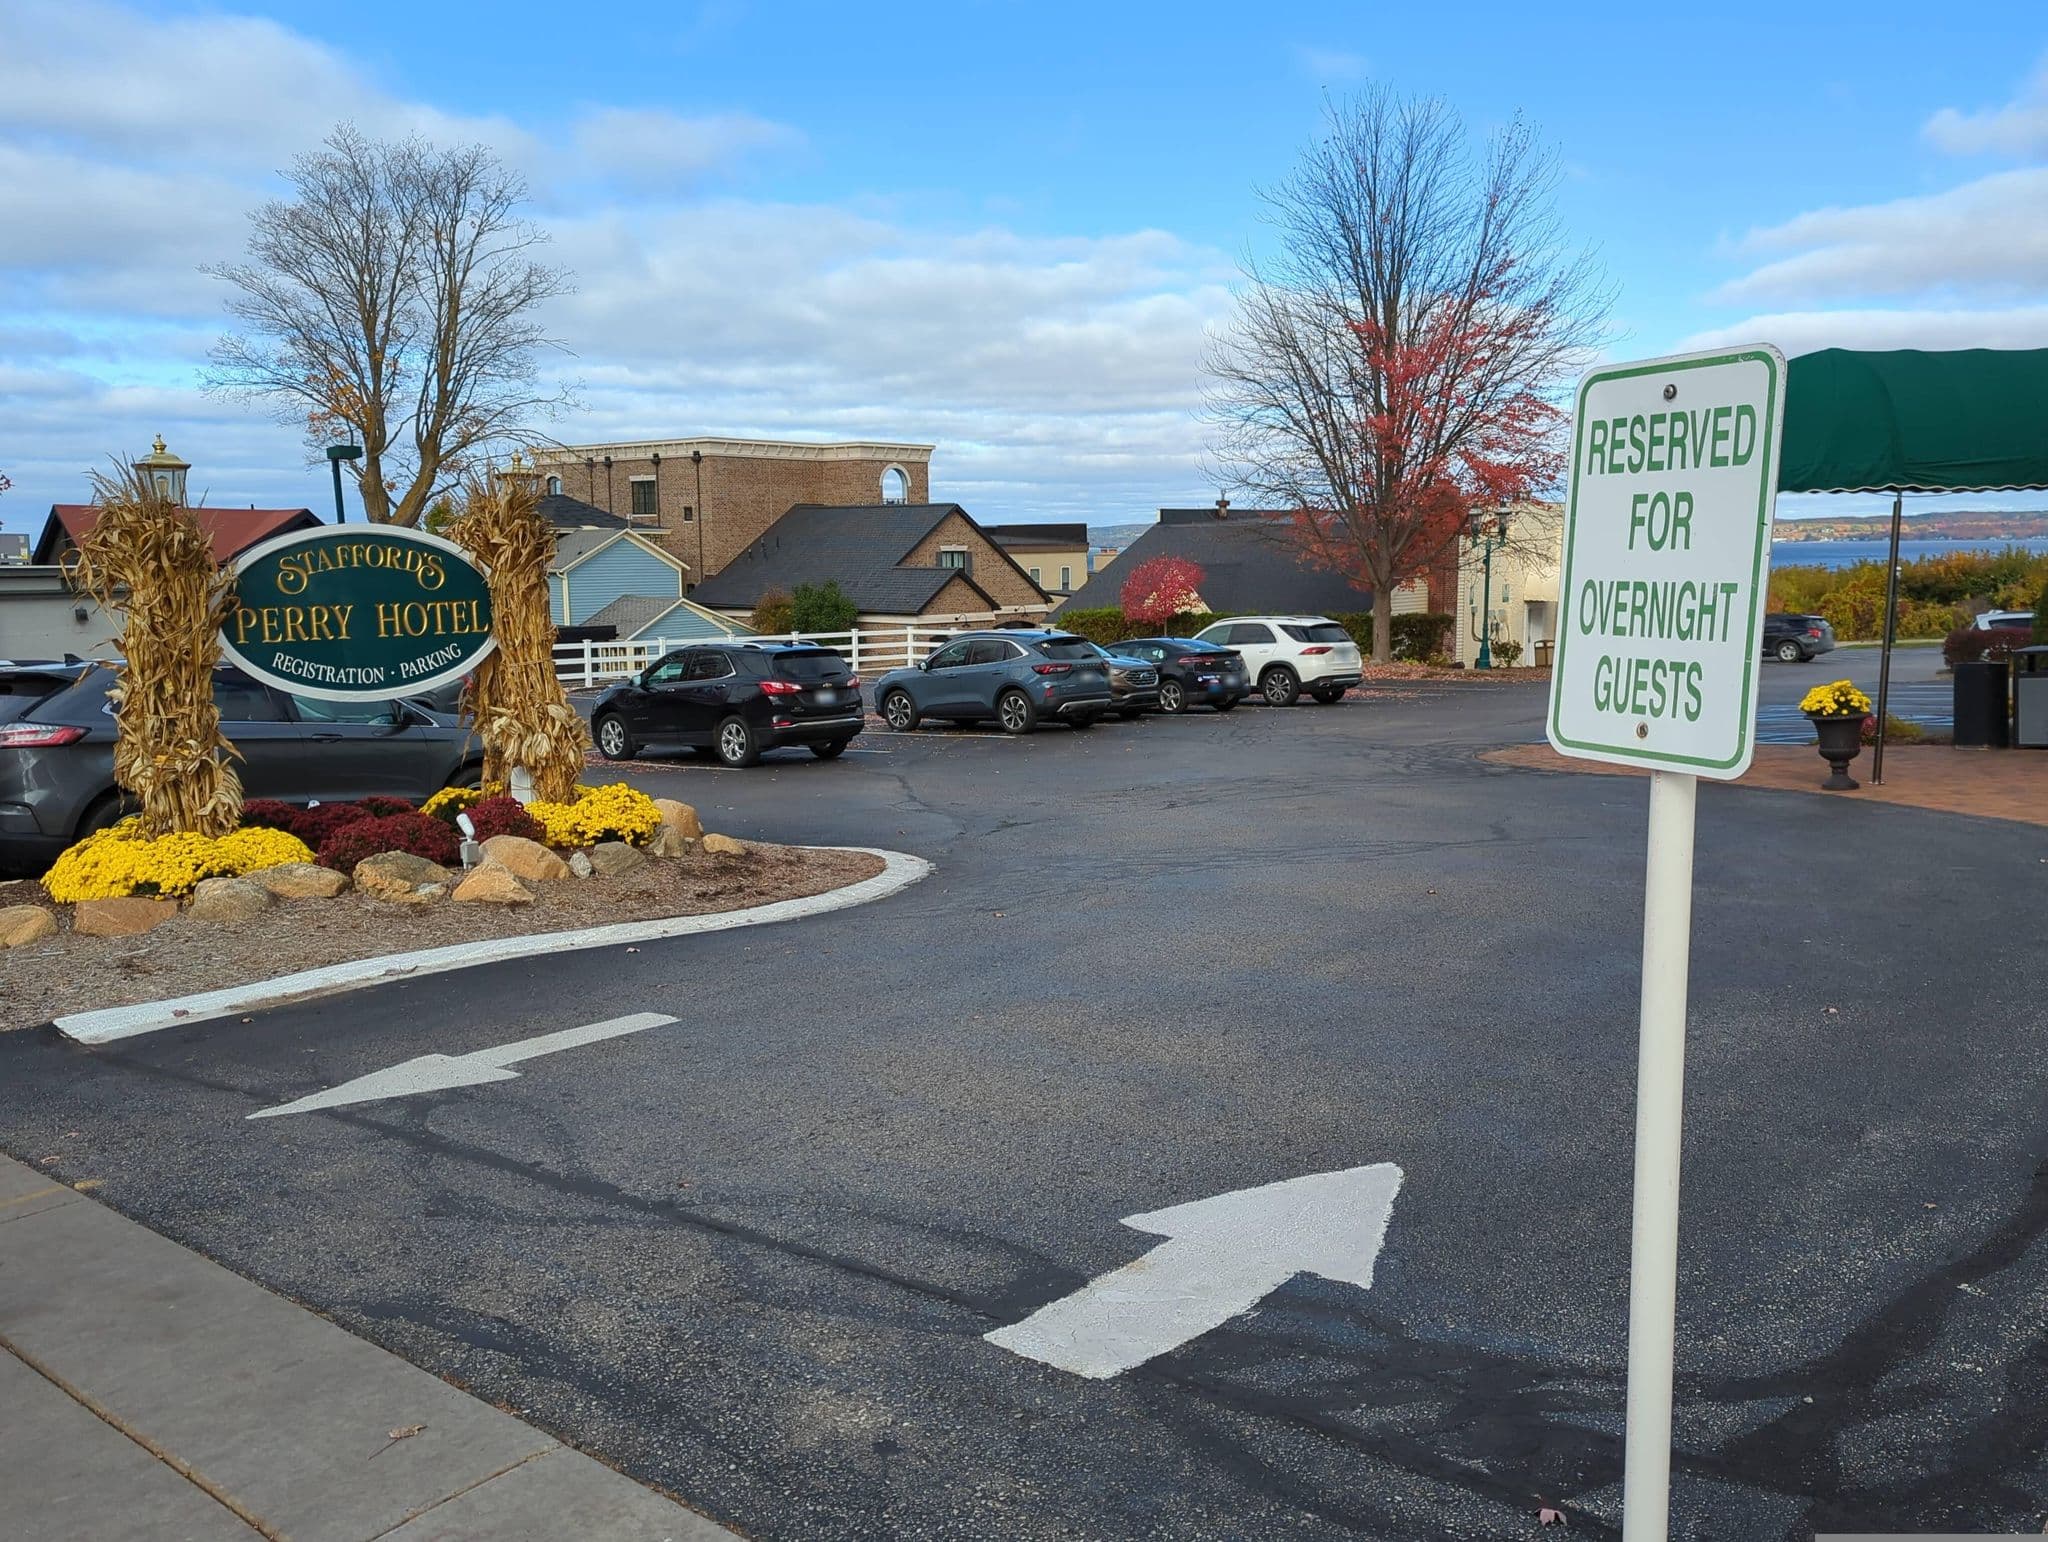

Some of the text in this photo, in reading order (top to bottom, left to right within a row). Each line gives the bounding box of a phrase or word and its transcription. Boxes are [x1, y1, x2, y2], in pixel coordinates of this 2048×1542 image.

[1587, 404, 1757, 475] RESERVED
[1628, 491, 1694, 551] FOR
[234, 599, 489, 645] PERRY HOTEL
[1579, 579, 1738, 642] OVERNIGHT
[272, 643, 462, 684] REGISTRATION PARKING
[1594, 655, 1703, 722] GUESTS
